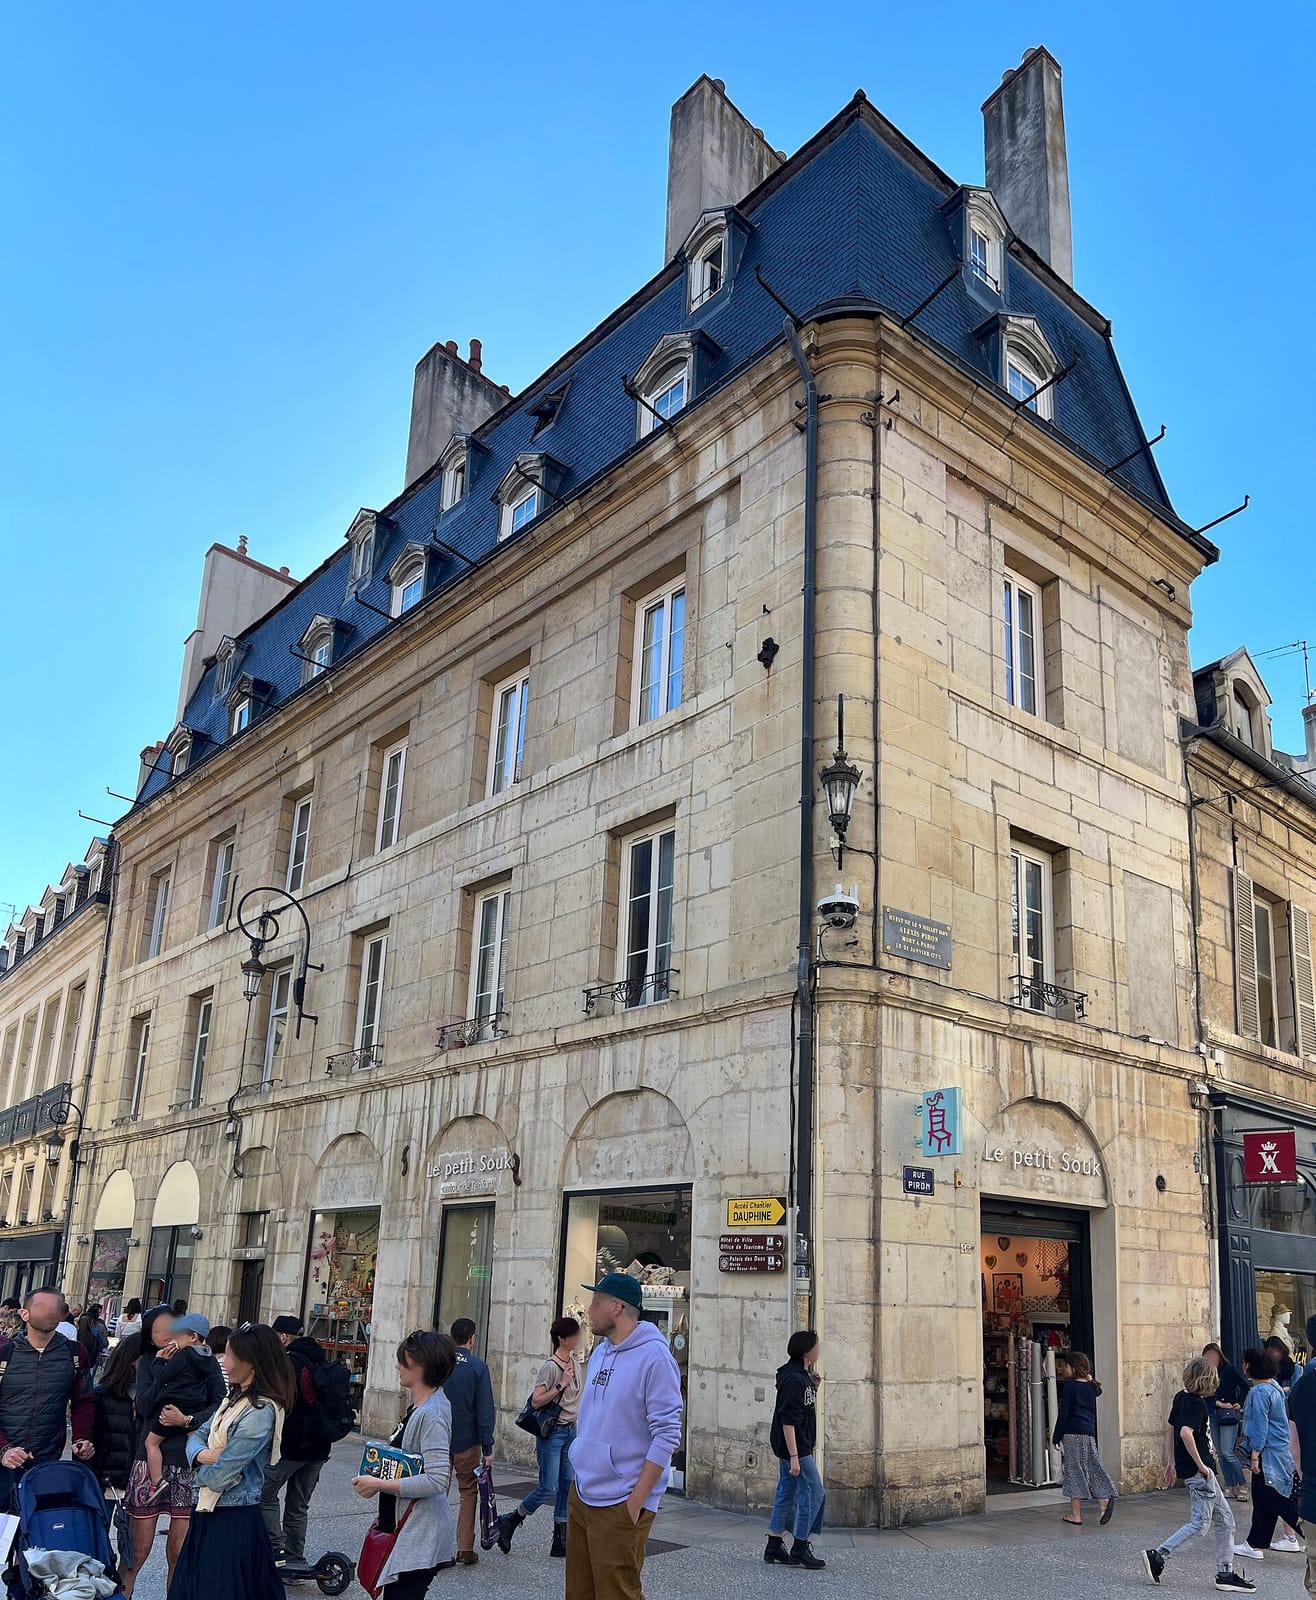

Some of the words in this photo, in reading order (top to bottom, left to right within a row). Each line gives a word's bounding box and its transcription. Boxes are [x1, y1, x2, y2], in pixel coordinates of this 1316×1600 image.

[900, 926, 920, 938] ALEXIS
[921, 932, 939, 943] PIRON
[922, 924, 938, 933] JUILLET
[901, 936, 915, 944] MORT
[920, 942, 936, 950] PARIS
[910, 946, 930, 957] JANVIER
[930, 952, 942, 960] 1773
[985, 1140, 1004, 1162] Le
[1013, 1148, 1054, 1170] petit
[1062, 1152, 1102, 1177] Souk
[426, 1162, 440, 1178] Le
[444, 1158, 475, 1180] petit
[480, 1151, 512, 1172] Souk
[912, 1170, 926, 1180] RUE
[908, 1180, 931, 1191] PIRON
[734, 1201, 749, 1210] Accès
[750, 1200, 772, 1209] Chantier
[733, 1210, 772, 1222] DAUPHINE
